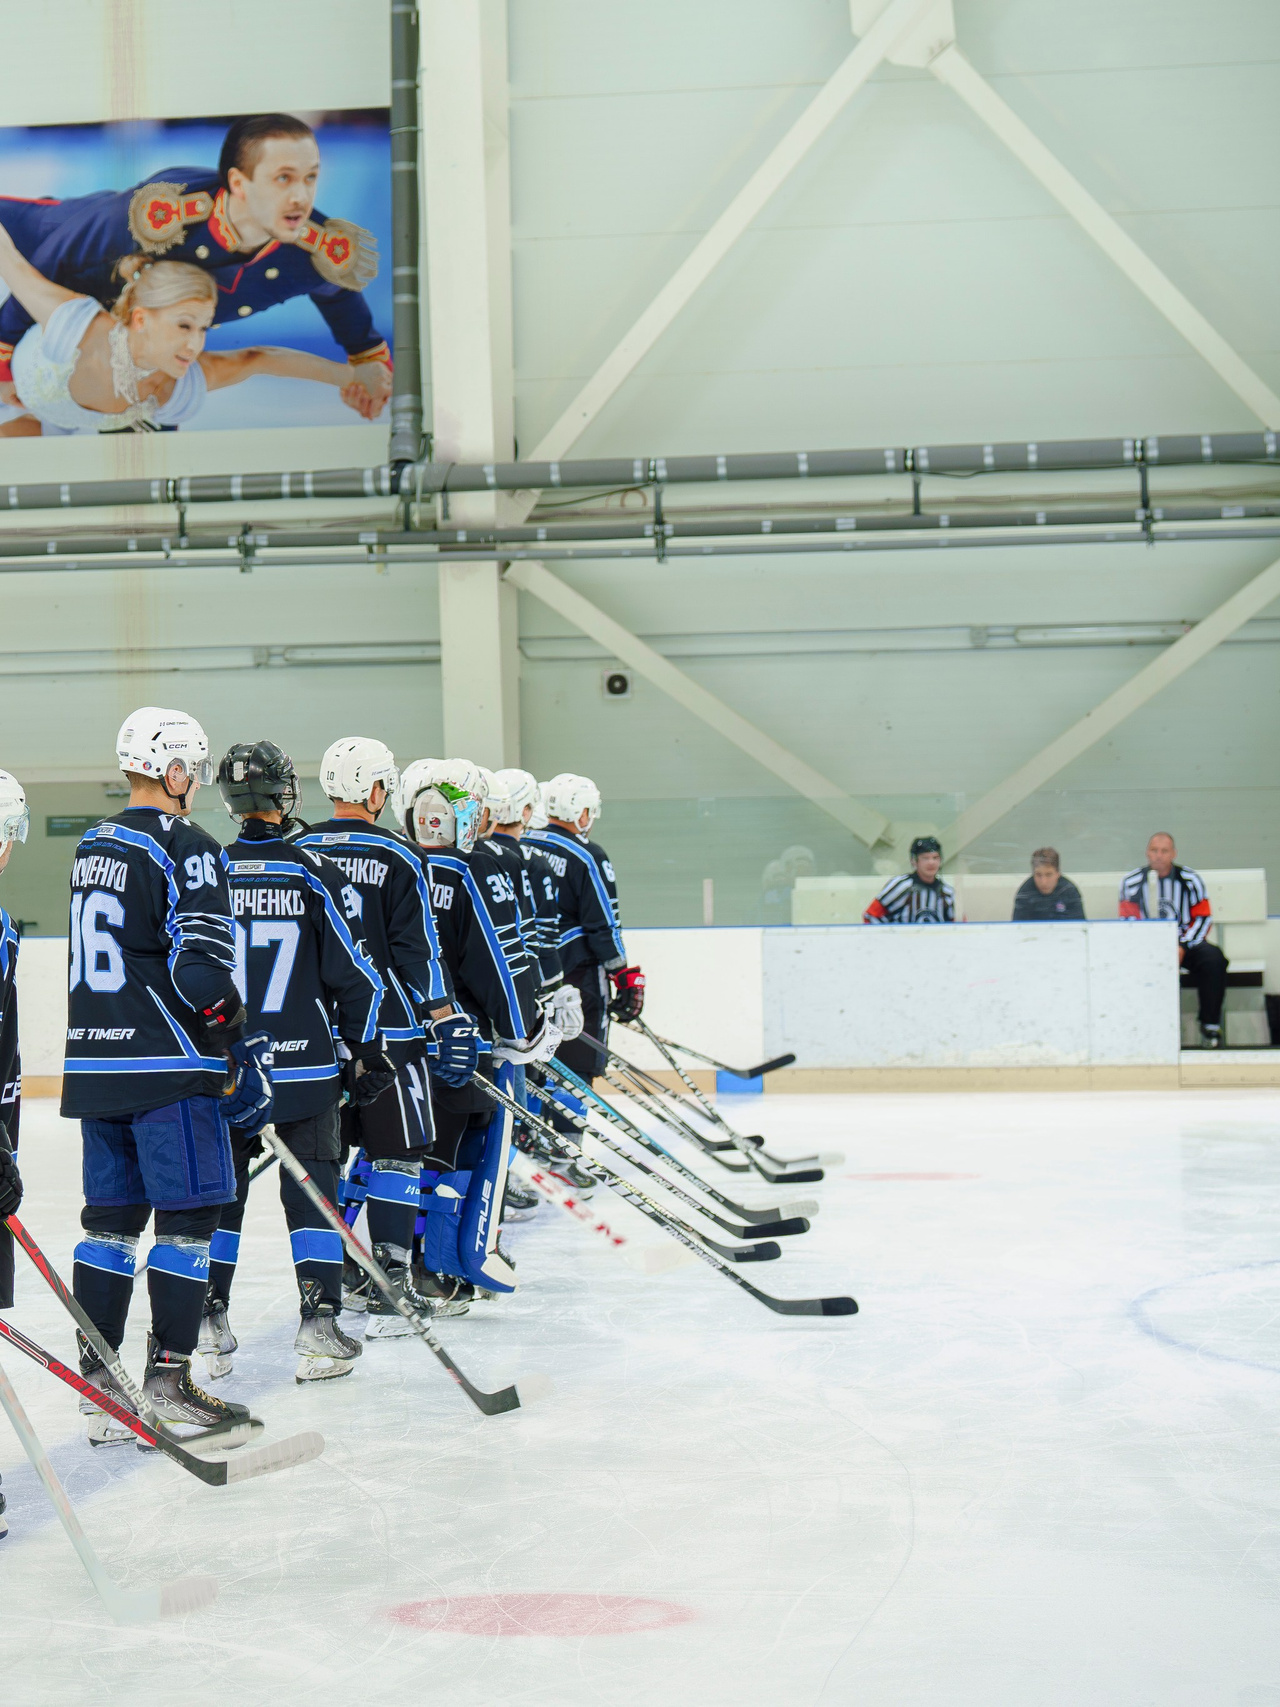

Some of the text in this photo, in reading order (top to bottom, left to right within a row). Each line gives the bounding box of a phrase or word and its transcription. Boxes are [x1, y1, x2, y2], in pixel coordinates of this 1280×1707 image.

[326, 770, 335, 781] 10
[184, 851, 218, 890] 96
[231, 888, 306, 916] ВЧЕНКО
[67, 1028, 136, 1040] NE TIMER
[475, 1179, 493, 1252] TRUE
[109, 1361, 152, 1415] BAUER
[151, 1390, 201, 1424] VAPOR
[182, 1402, 210, 1421] BAUER
